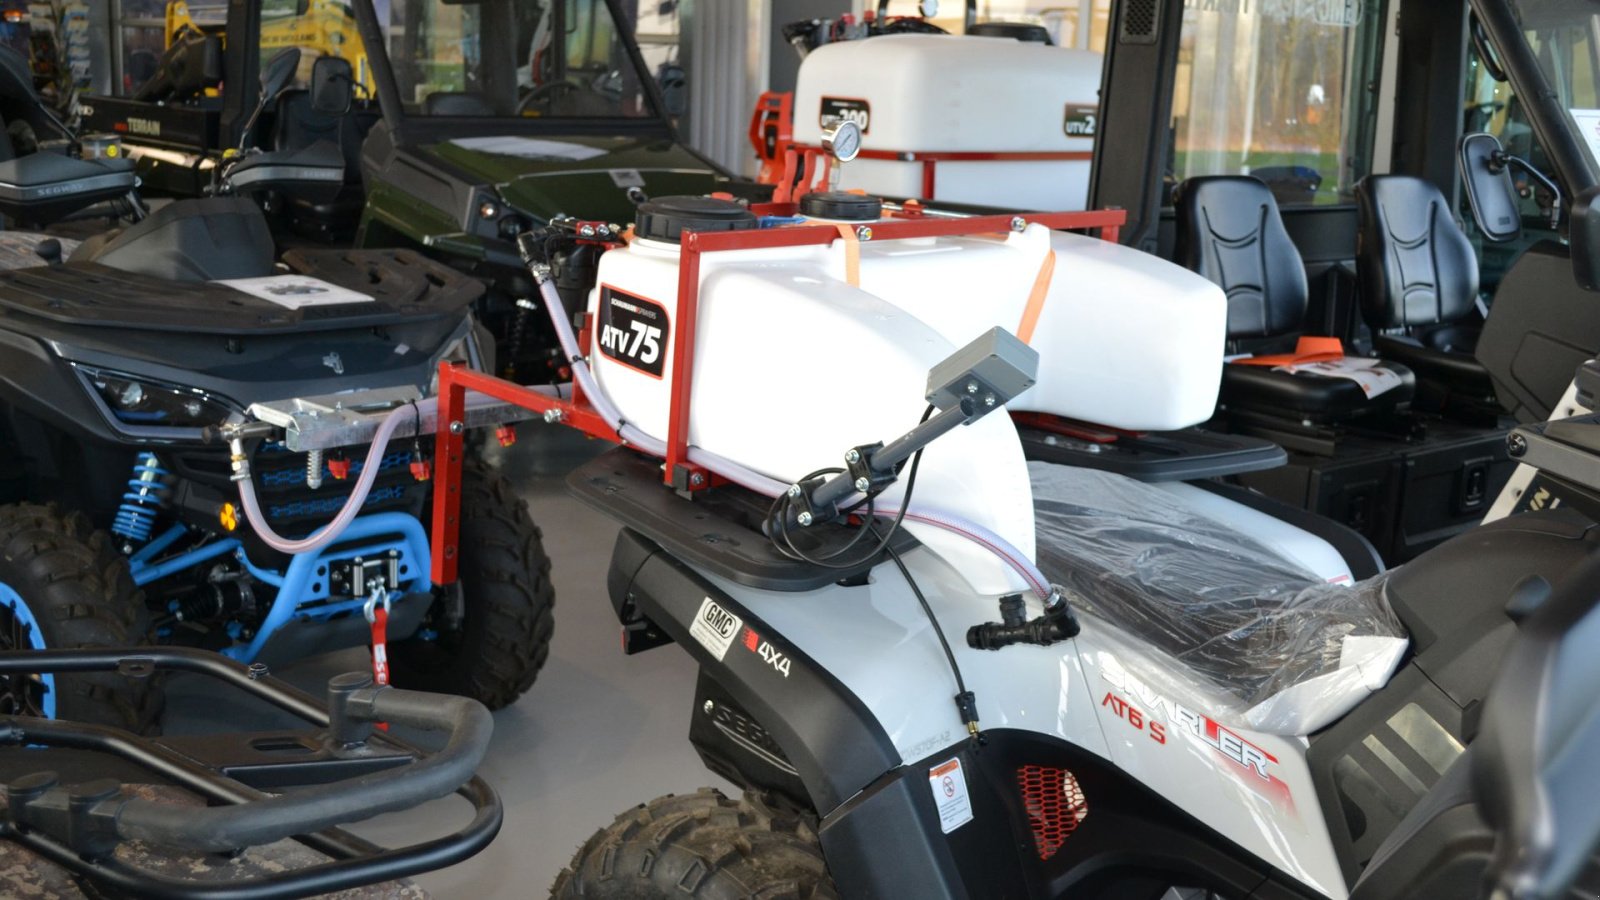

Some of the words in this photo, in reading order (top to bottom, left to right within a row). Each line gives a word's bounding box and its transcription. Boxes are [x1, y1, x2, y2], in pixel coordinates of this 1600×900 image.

[127, 117, 160, 136] TERRAIN
[1066, 121, 1087, 134] UTV
[37, 183, 83, 196] SEGWAY
[600, 323, 630, 354] ATV
[627, 319, 662, 364] 75
[705, 604, 733, 635] GMC
[1098, 652, 1270, 780] SNARLER
[1149, 720, 1166, 744] S
